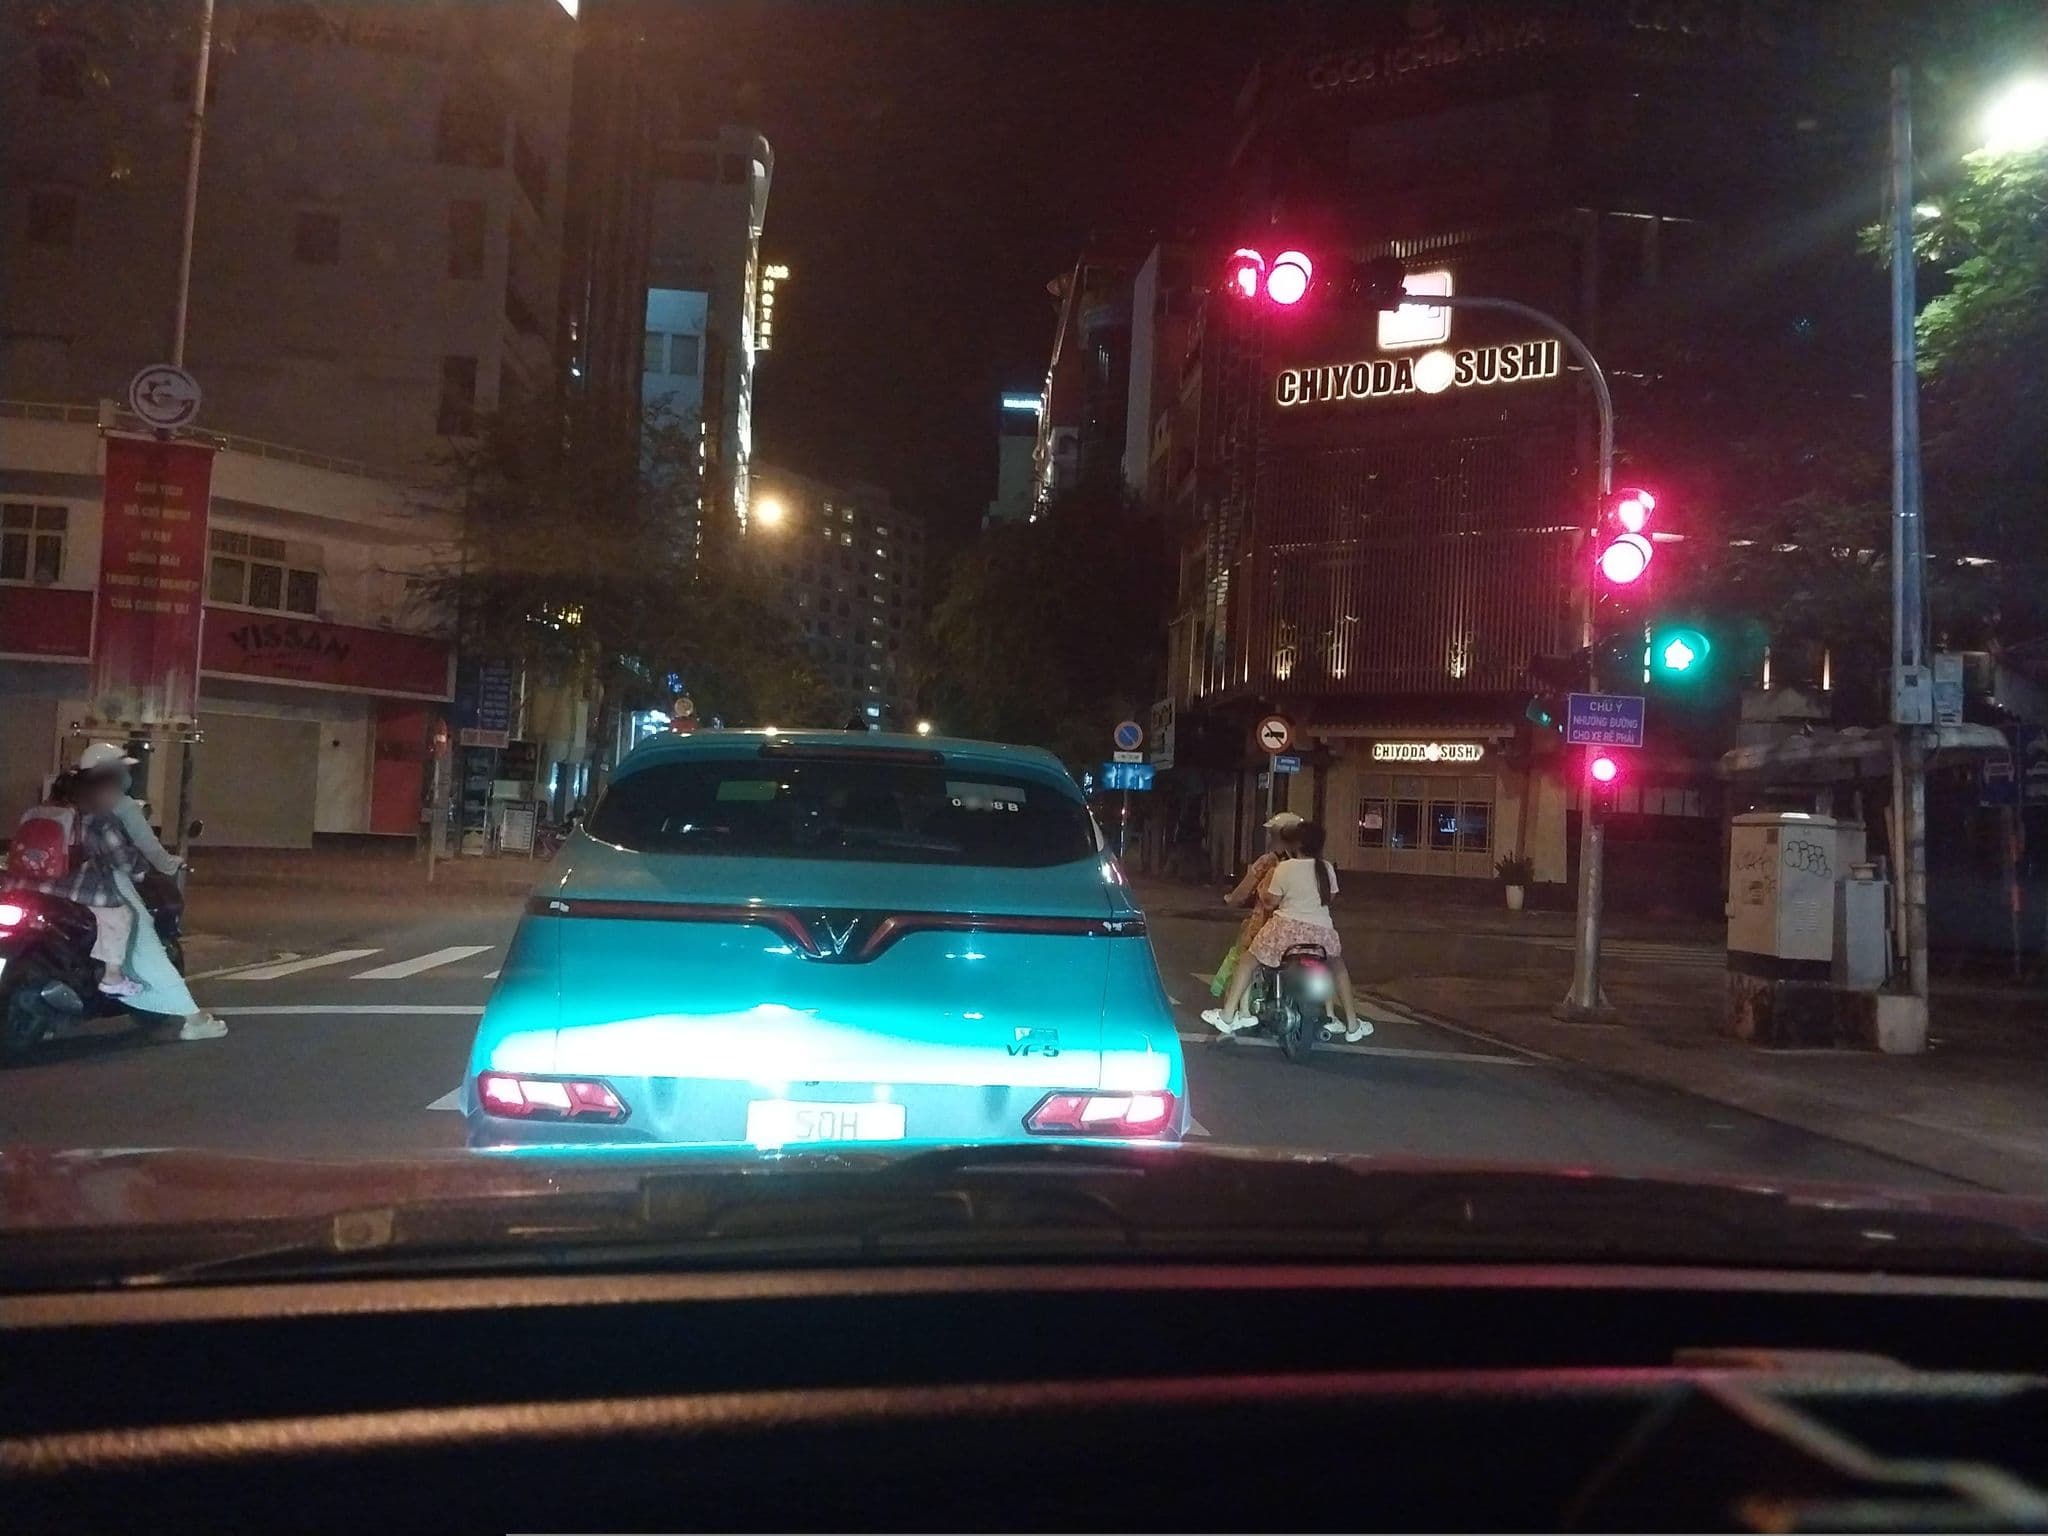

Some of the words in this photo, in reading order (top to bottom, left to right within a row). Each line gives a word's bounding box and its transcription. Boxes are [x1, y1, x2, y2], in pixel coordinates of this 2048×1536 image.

[1277, 357, 1415, 404] CHIYODA
[1454, 340, 1559, 385] SUSHI
[1573, 729, 1591, 740] CHO
[1373, 744, 1427, 760] CHIYODA
[796, 1110, 858, 1140] 50H
